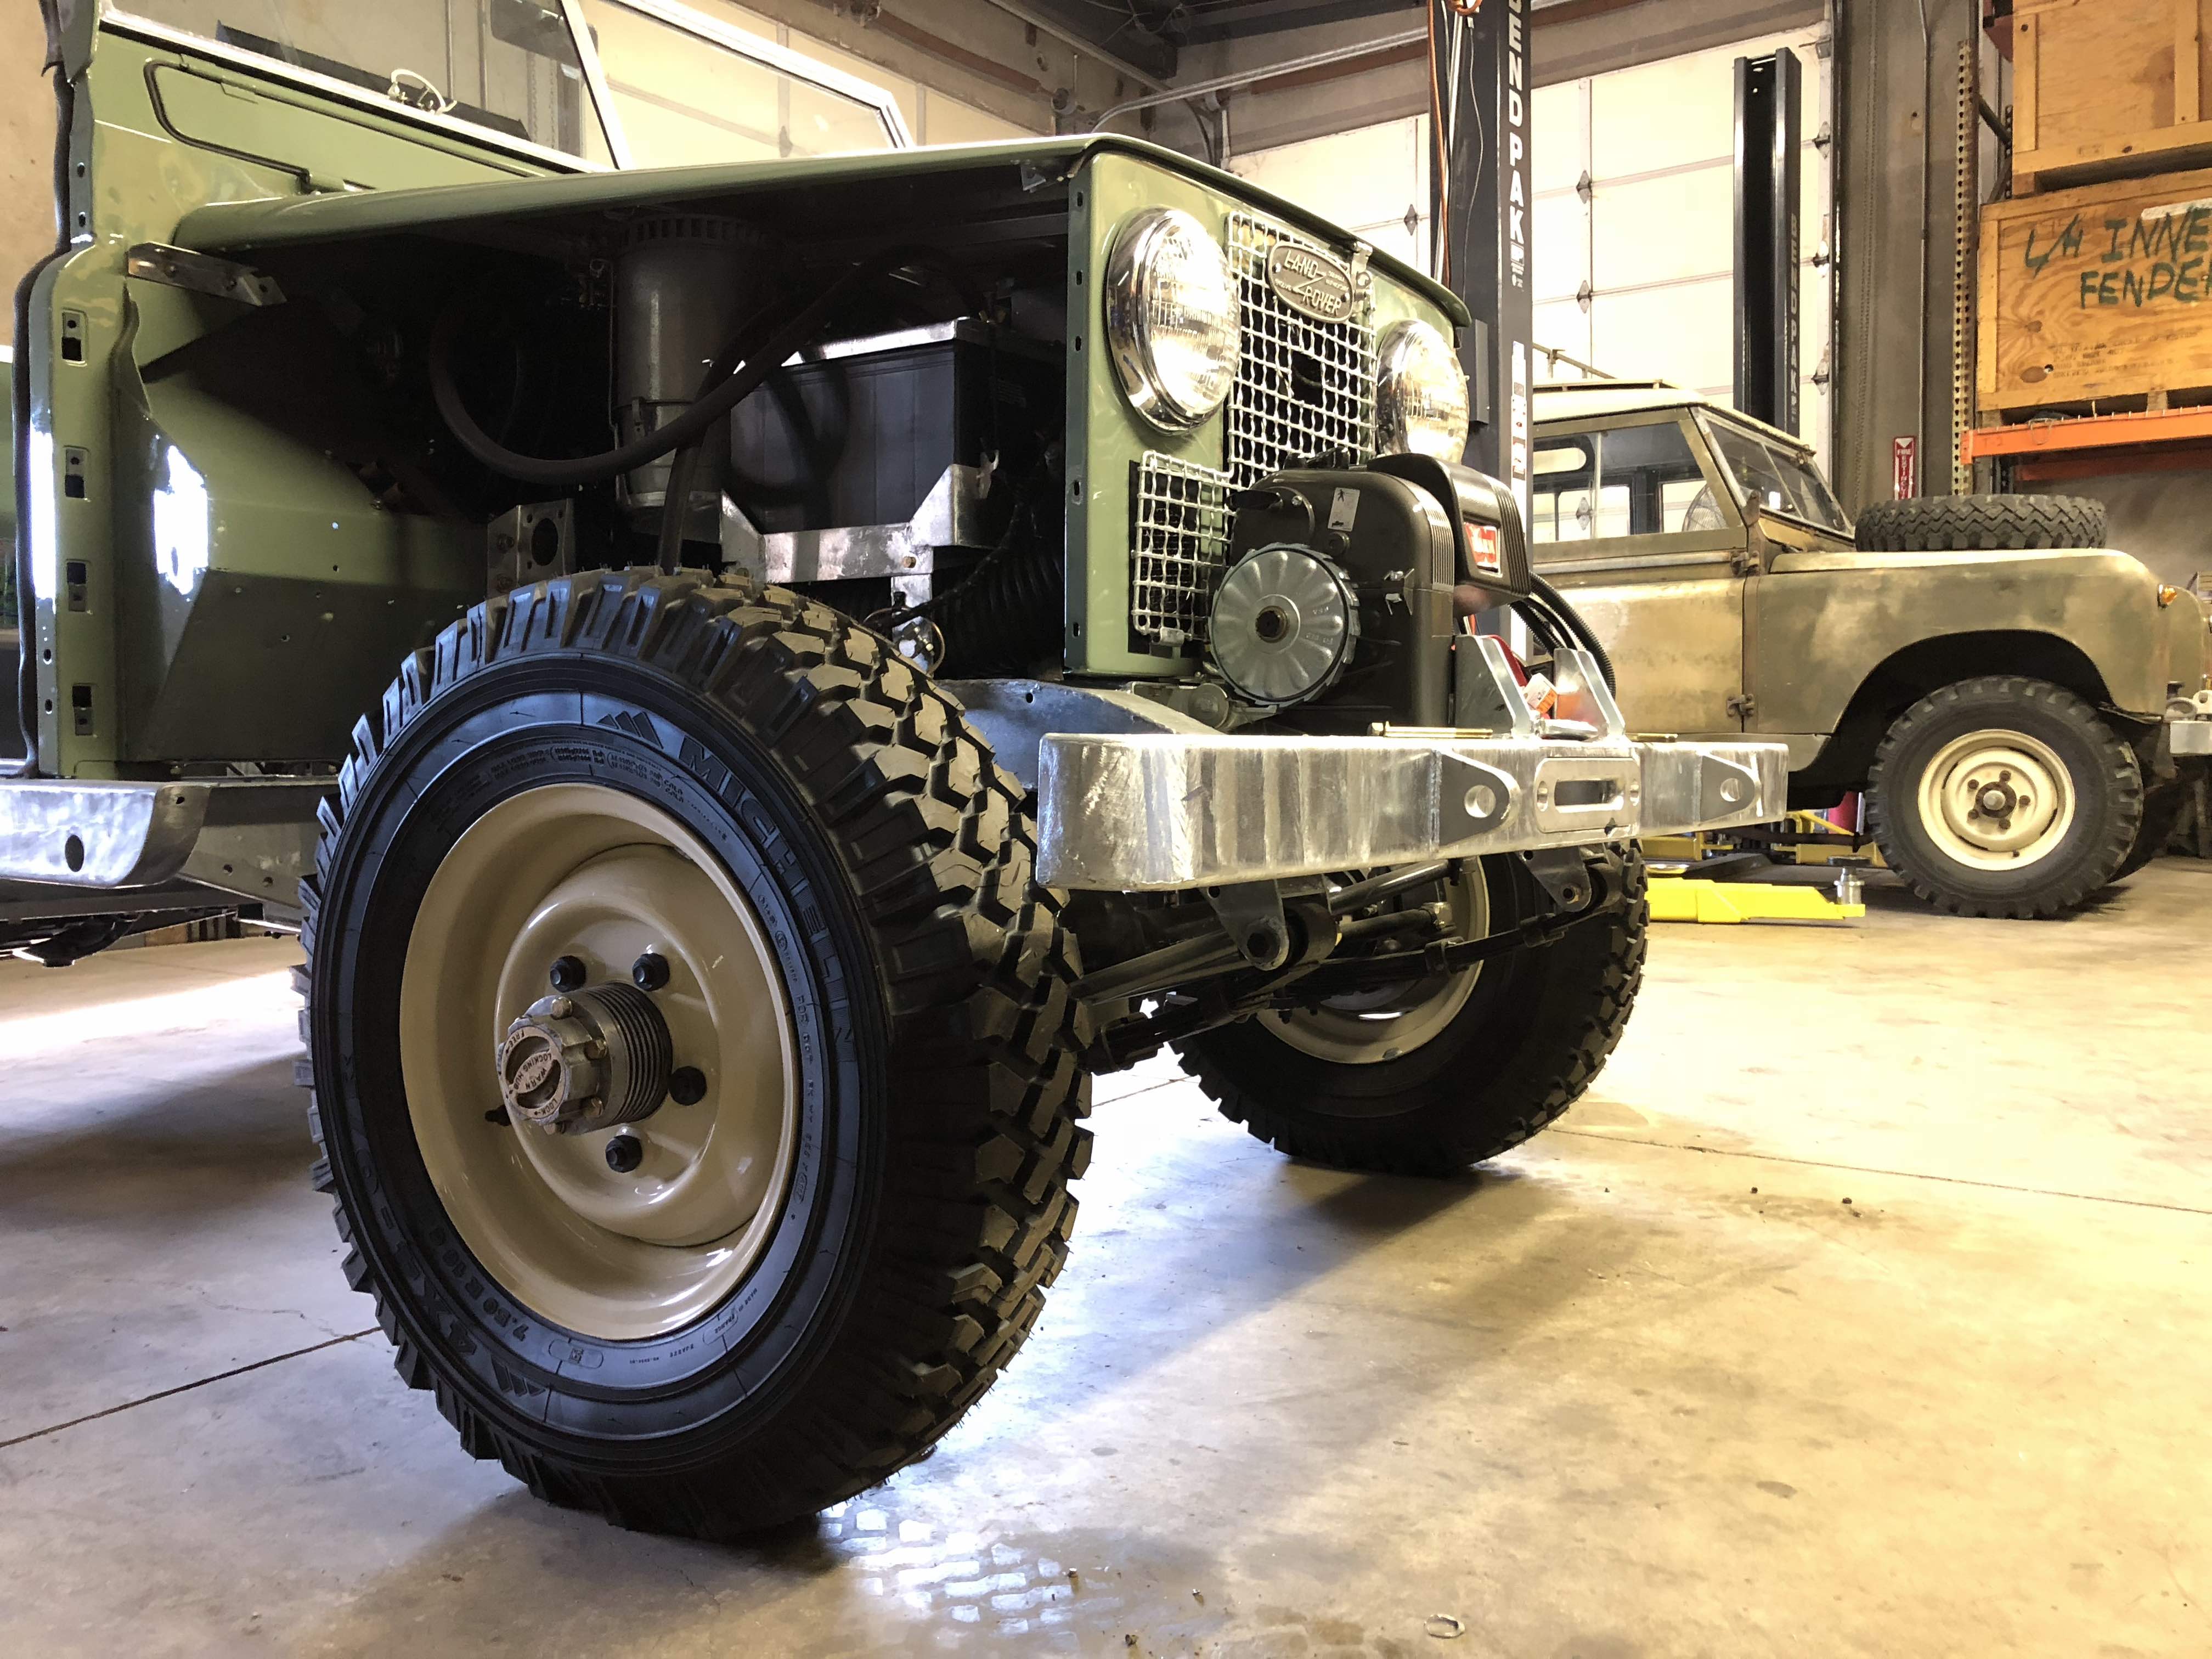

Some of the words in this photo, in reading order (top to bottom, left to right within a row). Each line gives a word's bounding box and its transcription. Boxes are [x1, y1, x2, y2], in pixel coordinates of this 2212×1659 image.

[1284, 250, 1318, 278] LAND
[2081, 257, 2212, 309] FENDE
[1302, 285, 1342, 317] ROVER
[679, 735, 855, 1062] MICHELIN
[523, 1053, 552, 1072] LOCKING
[525, 1068, 547, 1090] WARN
[541, 1098, 558, 1115] LOCK
